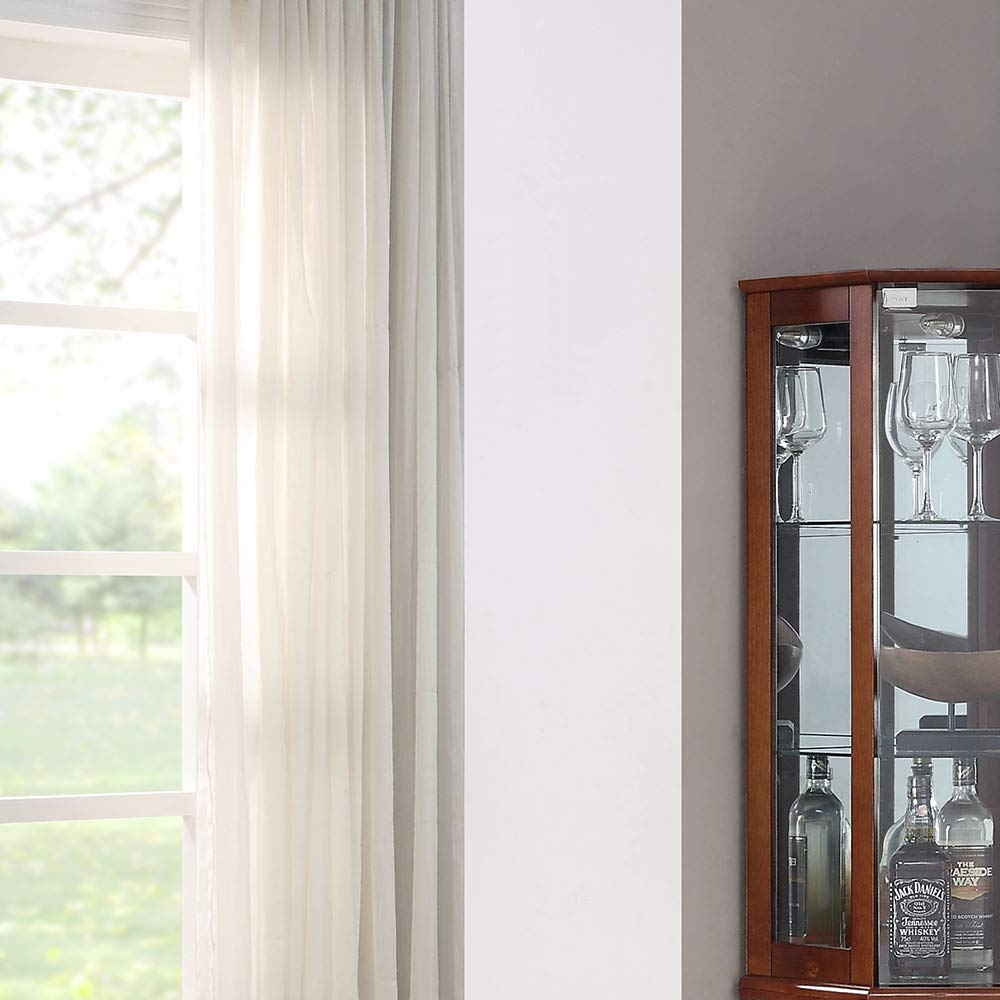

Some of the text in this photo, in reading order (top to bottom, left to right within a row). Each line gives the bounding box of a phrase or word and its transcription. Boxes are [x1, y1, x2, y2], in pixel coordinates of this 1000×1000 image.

[953, 877, 979, 886] WAY
[894, 884, 914, 900] JACK
[901, 917, 939, 927] Tennessee
[900, 928, 941, 936] WHISKEY
